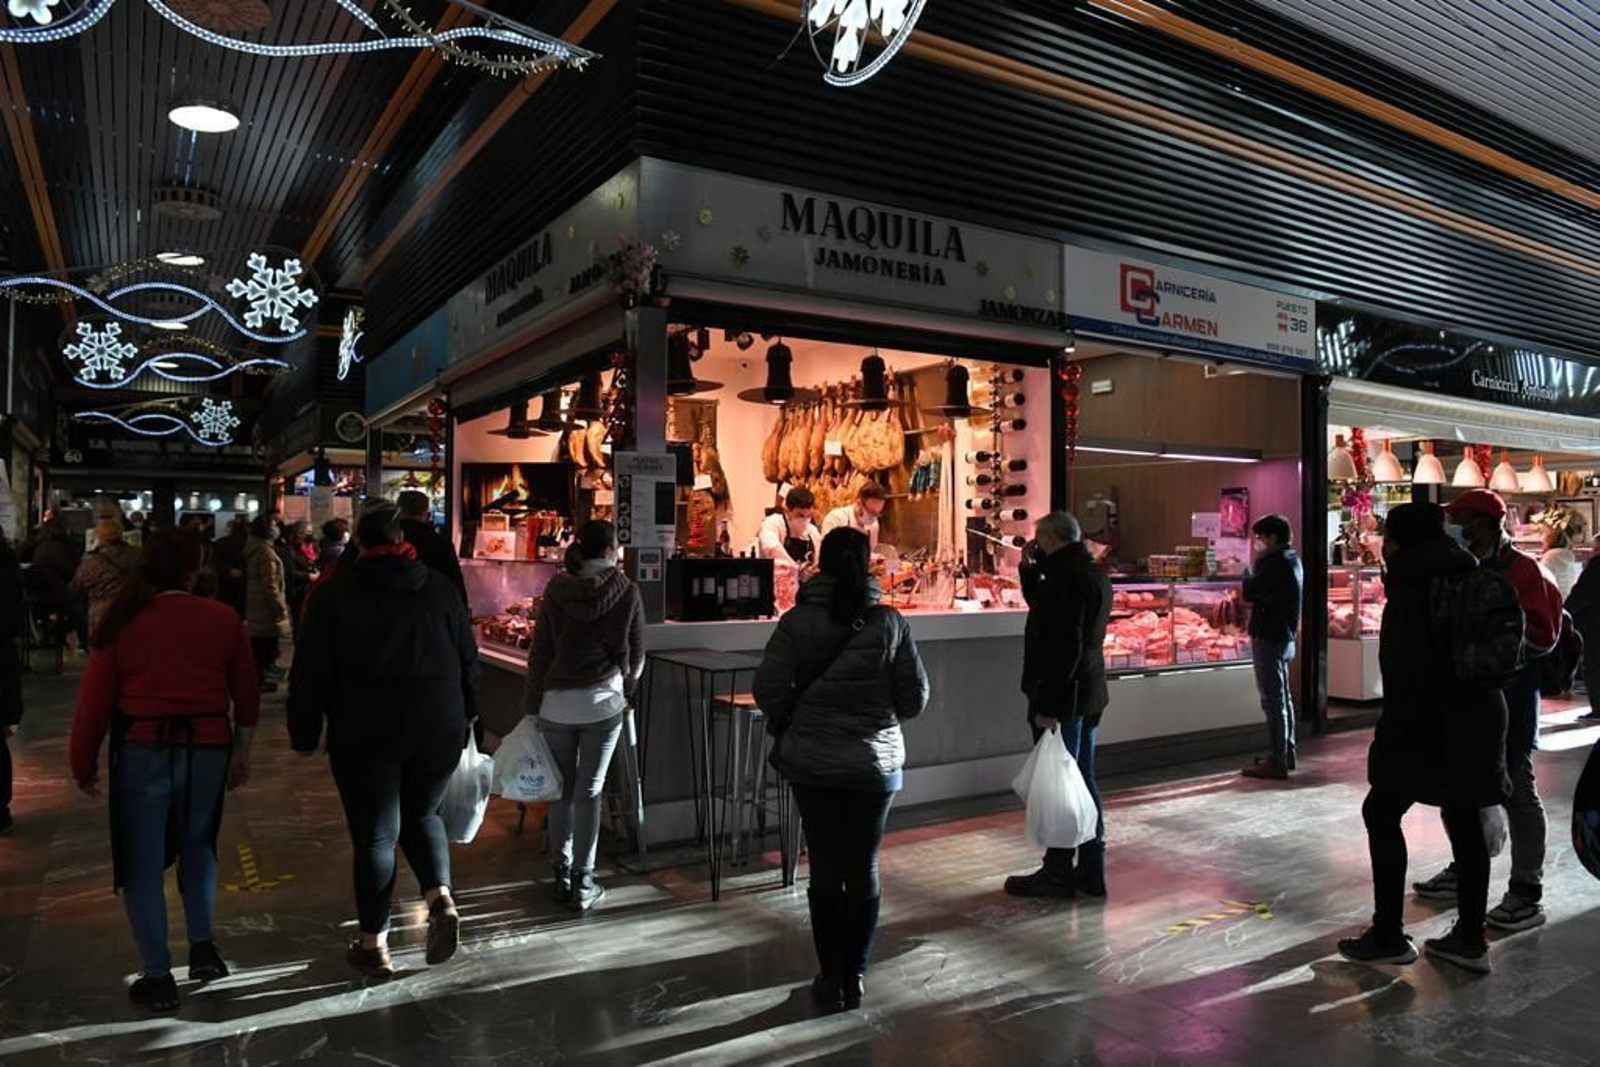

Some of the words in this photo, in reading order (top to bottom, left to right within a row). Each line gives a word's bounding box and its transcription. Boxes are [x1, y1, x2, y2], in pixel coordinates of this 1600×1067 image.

[780, 192, 966, 263] MAQUILA
[814, 247, 946, 286] JAMONERÍA
[1290, 317, 1307, 333] 38
